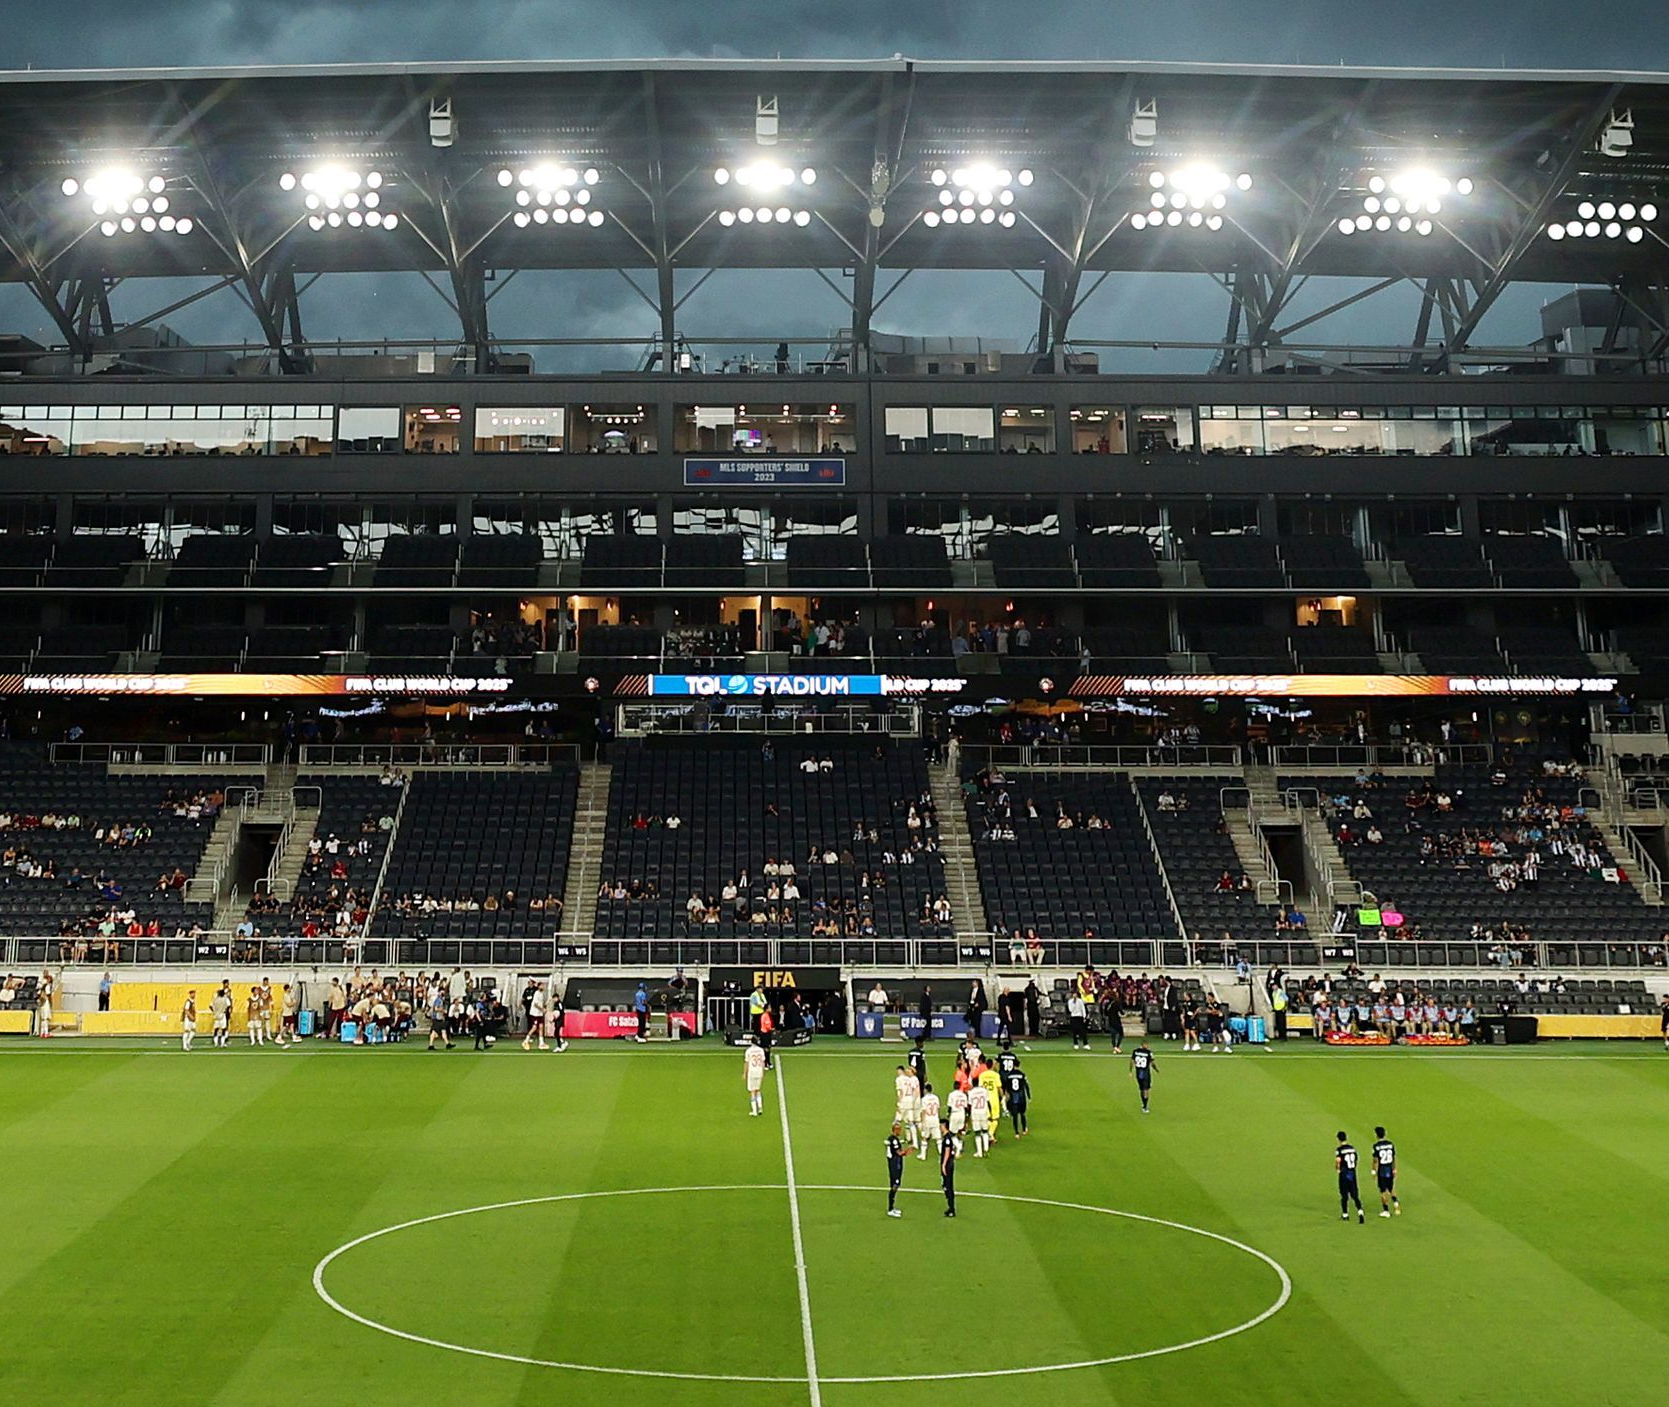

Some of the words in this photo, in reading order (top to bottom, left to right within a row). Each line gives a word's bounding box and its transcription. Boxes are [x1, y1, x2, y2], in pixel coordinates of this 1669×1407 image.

[719, 463, 735, 472] MLS
[785, 463, 809, 472] SHIELD
[754, 473, 775, 481] 2023
[24, 678, 50, 690] FIFA
[51, 678, 82, 690] CLUB
[84, 678, 128, 690] WORLD
[128, 678, 153, 690] CUP
[346, 678, 372, 690] FIFA
[374, 678, 405, 690] CLUB
[406, 678, 450, 690] WORLD
[451, 678, 476, 690] CUP
[685, 676, 728, 696] TQL
[752, 676, 849, 695] STADIUM
[905, 678, 930, 691] CUP
[1185, 679, 1229, 691] WORLD
[1449, 679, 1476, 691] FIFA
[1477, 679, 1508, 691] CLUB
[1510, 679, 1554, 691] WORLD
[1555, 679, 1581, 691] CUP
[753, 971, 796, 988] FIFA
[608, 1016, 618, 1027] FC
[901, 1017, 910, 1028] CF
[1012, 1078, 1019, 1091] 8
